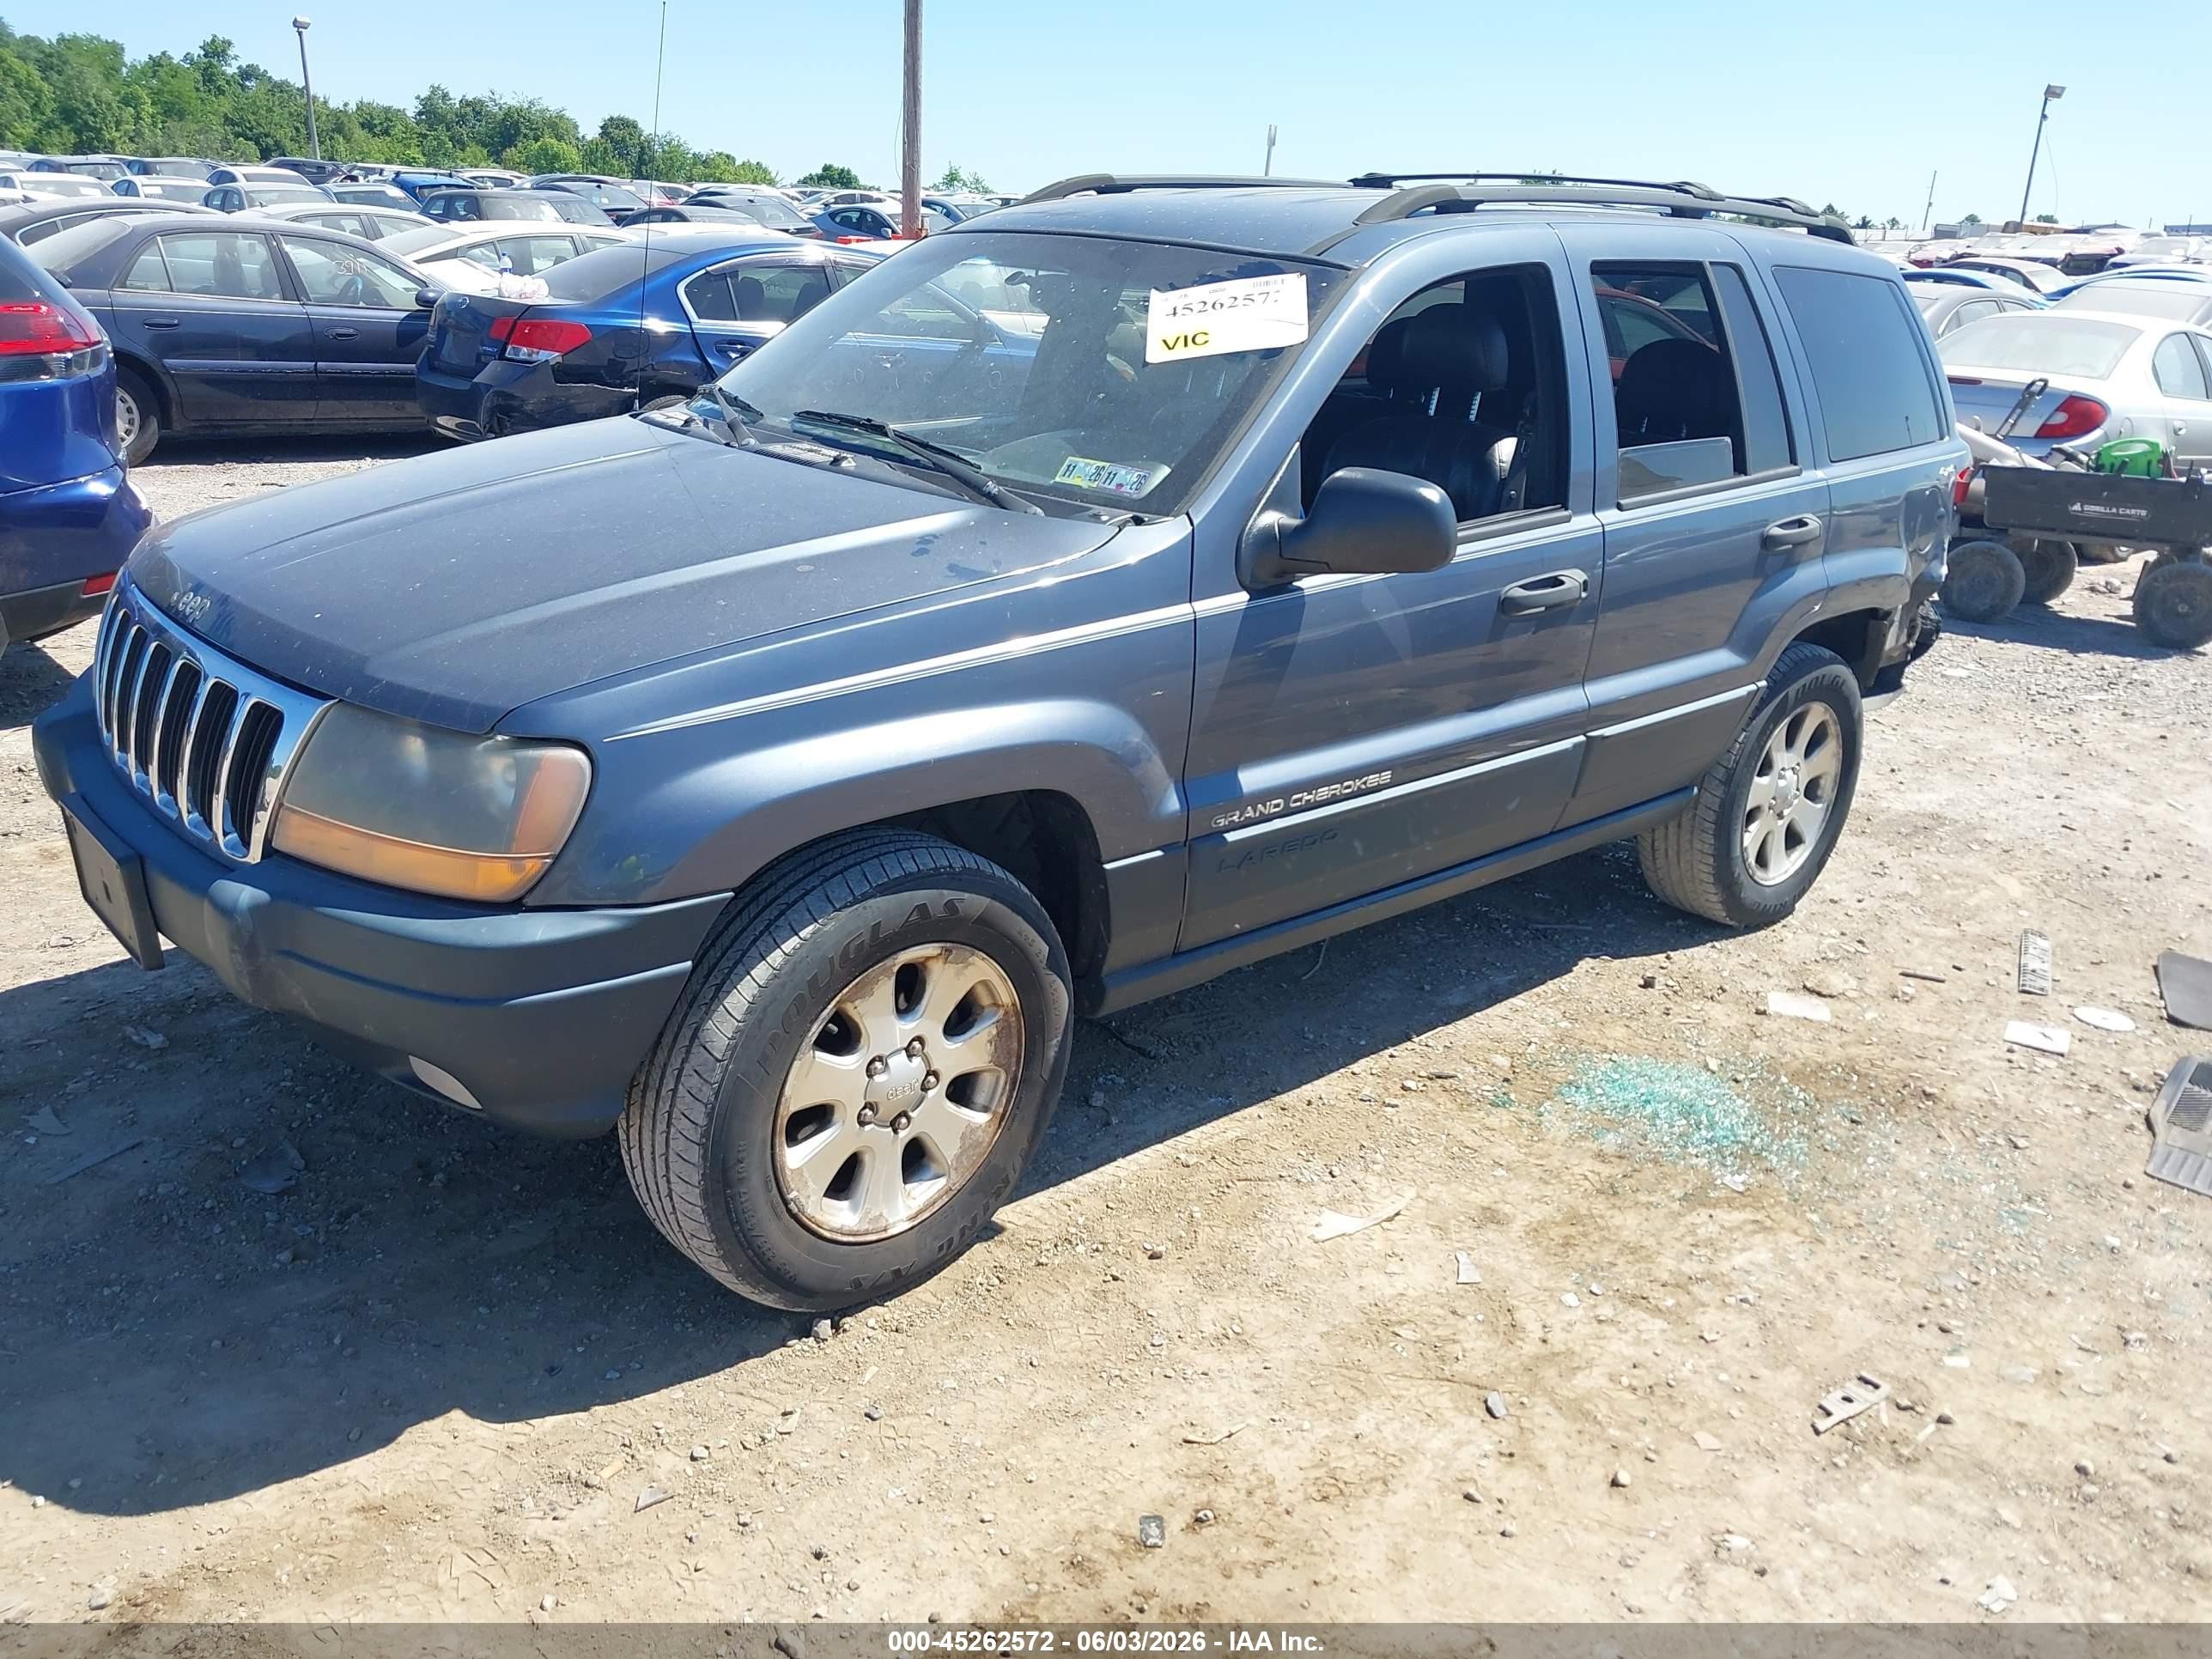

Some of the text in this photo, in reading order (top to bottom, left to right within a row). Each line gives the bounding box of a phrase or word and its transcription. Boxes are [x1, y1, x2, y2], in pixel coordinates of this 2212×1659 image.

[1161, 332, 1210, 350] VIC
[1210, 769, 1393, 828] GRAND CHEROKEE
[1217, 828, 1340, 873] LAREDO
[756, 897, 967, 1077] DOUGLAS
